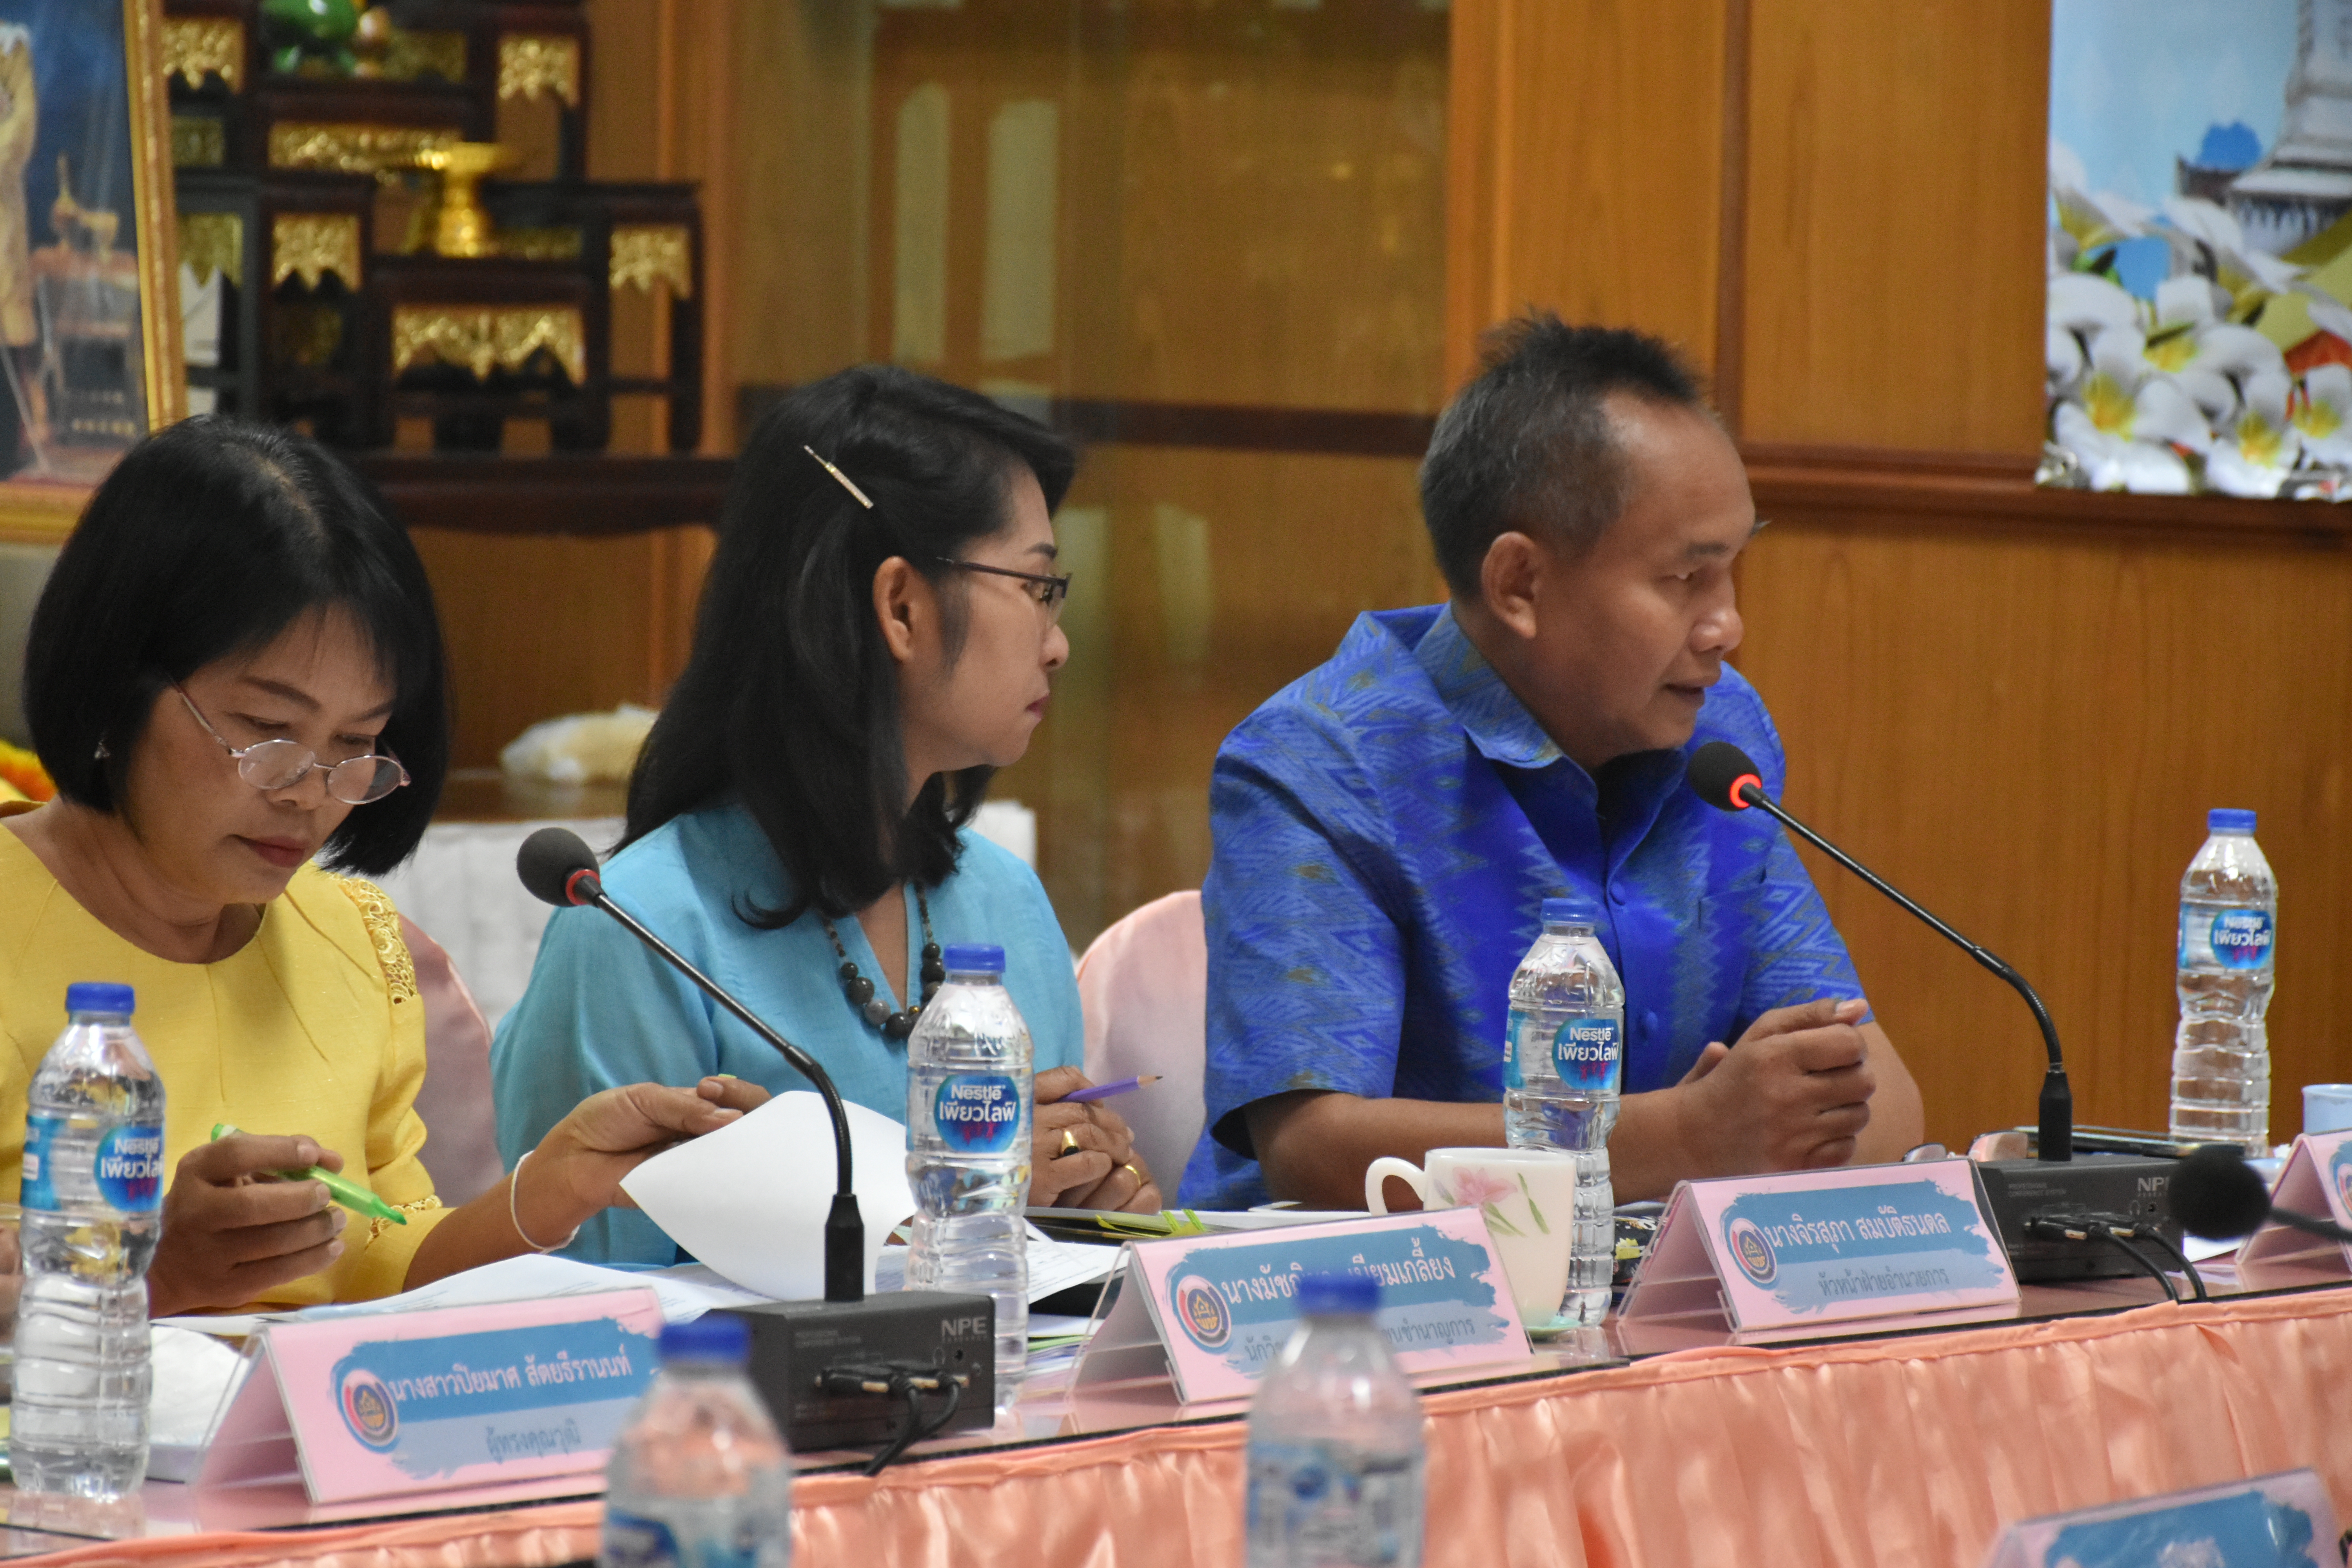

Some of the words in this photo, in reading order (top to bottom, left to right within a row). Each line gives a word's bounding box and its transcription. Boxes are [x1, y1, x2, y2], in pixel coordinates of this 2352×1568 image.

[1570, 1027, 1612, 1042] Nestlé
[1559, 1041, 1619, 1061] เพียวไลฟ์
[951, 1084, 1002, 1100] Nestlé
[940, 1100, 1016, 1122] เพียวไลฟ์
[1764, 1213, 1856, 1253] นางจิรสุภา
[1856, 1205, 1951, 1240] สมบัติธนดล
[1817, 1265, 1950, 1296] หัวหน้าฝ่ายอำนวยการ
[941, 1316, 988, 1337] NPE
[388, 1362, 522, 1401] นางสาวปิยมาศ
